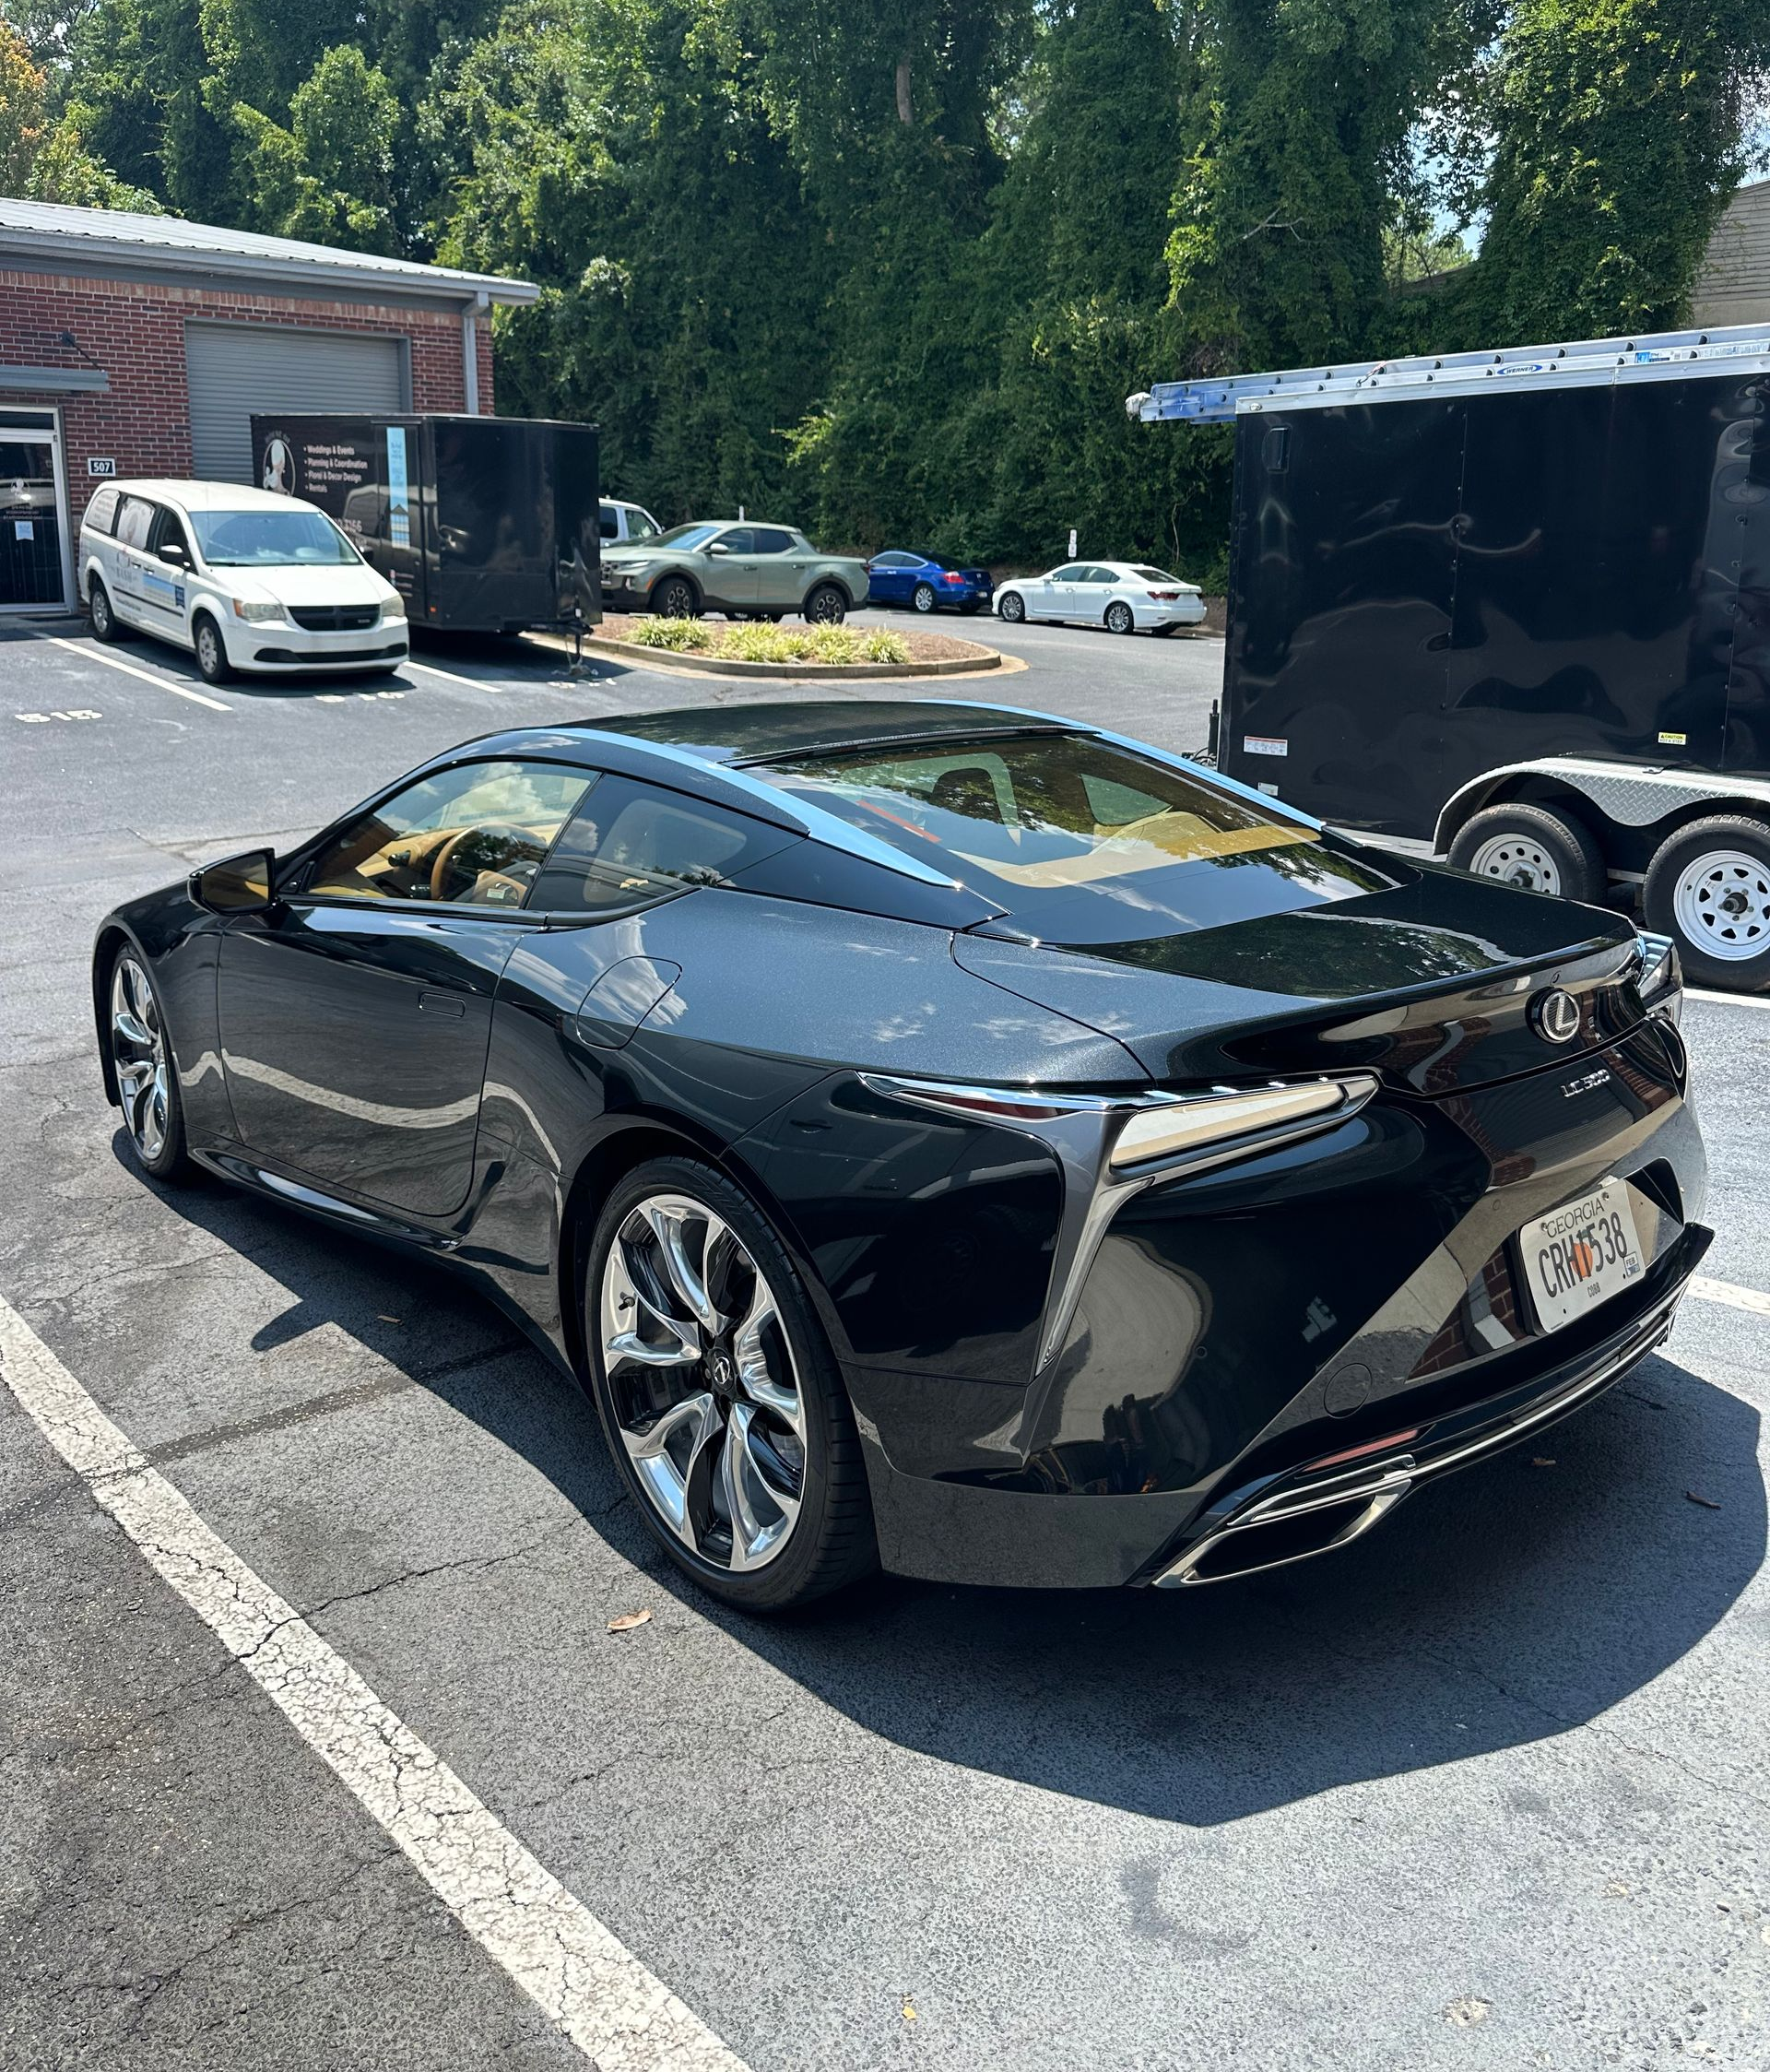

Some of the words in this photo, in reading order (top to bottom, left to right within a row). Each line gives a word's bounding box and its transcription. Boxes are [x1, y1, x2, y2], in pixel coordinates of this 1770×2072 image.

[307, 444, 332, 456] Weddings
[337, 444, 355, 456] Events
[93, 462, 111, 473] 507
[307, 457, 329, 468] Planning
[334, 458, 368, 469] Coordination
[309, 470, 323, 480] Floral
[343, 472, 362, 483] Design
[309, 482, 328, 493] Rentals
[15, 709, 103, 723] 515
[1546, 1197, 1605, 1238] GEORGIA
[1538, 1211, 1628, 1298] CRH1538
[1625, 1257, 1636, 1267] FEB
